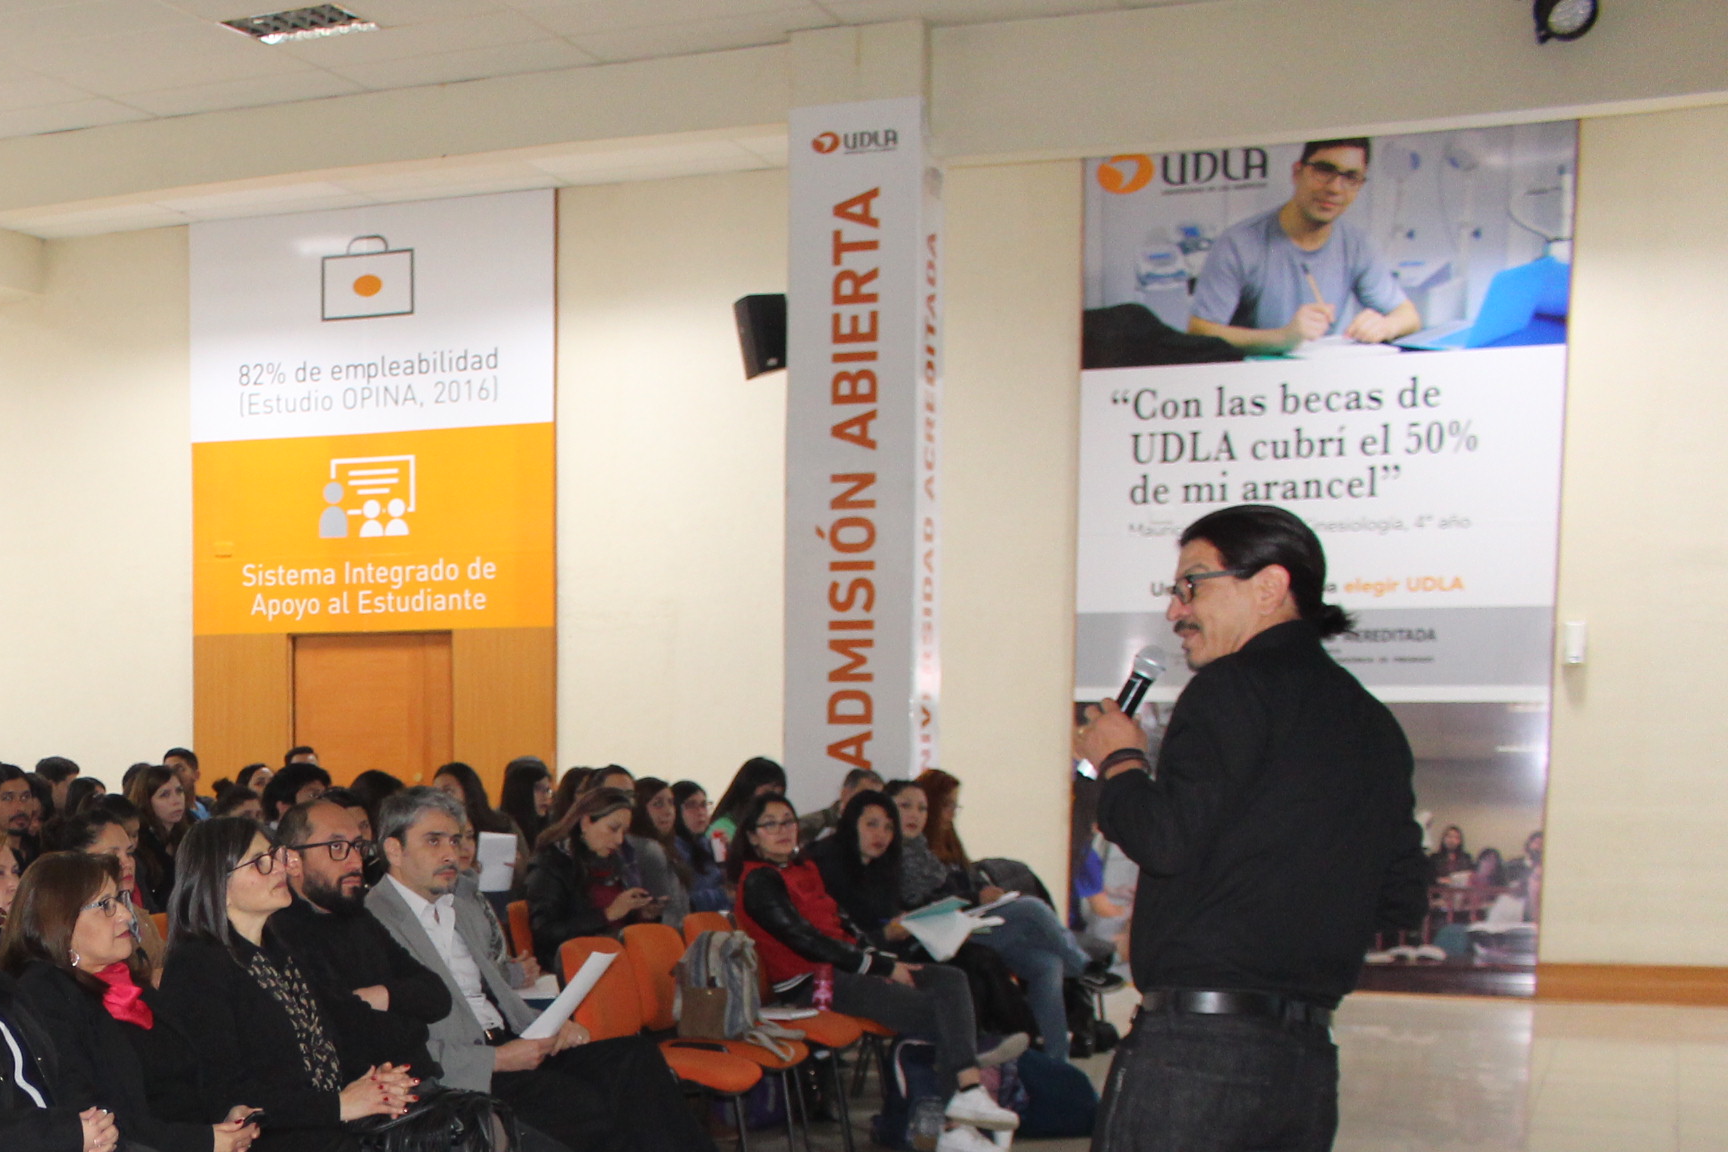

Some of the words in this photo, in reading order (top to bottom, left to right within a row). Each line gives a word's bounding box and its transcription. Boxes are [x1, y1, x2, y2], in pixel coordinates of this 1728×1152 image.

[843, 129, 898, 150] UDLA
[1161, 147, 1268, 186] UDLA
[830, 186, 881, 451] ABIERTA
[238, 361, 287, 387] 82%
[295, 360, 322, 383] de
[331, 347, 499, 384] empleabilidad
[239, 390, 334, 418] (Estudio
[342, 384, 425, 411] OPINA,
[434, 375, 499, 404] 2016)
[1111, 387, 1203, 420] “Con
[1215, 385, 1267, 417] las
[1280, 382, 1384, 415] becas
[1397, 376, 1441, 409] de
[1131, 430, 1238, 464] UDLA
[1251, 425, 1346, 461] cubrí
[1360, 423, 1393, 456] el
[1405, 418, 1479, 454] 50%
[1129, 474, 1170, 505] de
[1182, 470, 1229, 503] mi
[1242, 463, 1402, 501] arancel”
[242, 563, 336, 587] Sistema
[344, 557, 460, 590] Integrado
[467, 556, 497, 580] de
[1344, 577, 1401, 597] elegir
[1406, 575, 1466, 592] UDLA
[251, 593, 321, 622] Apoyo
[328, 591, 350, 615] al
[359, 587, 488, 615] Estudiante
[815, 472, 877, 771] ADMISIÓN
